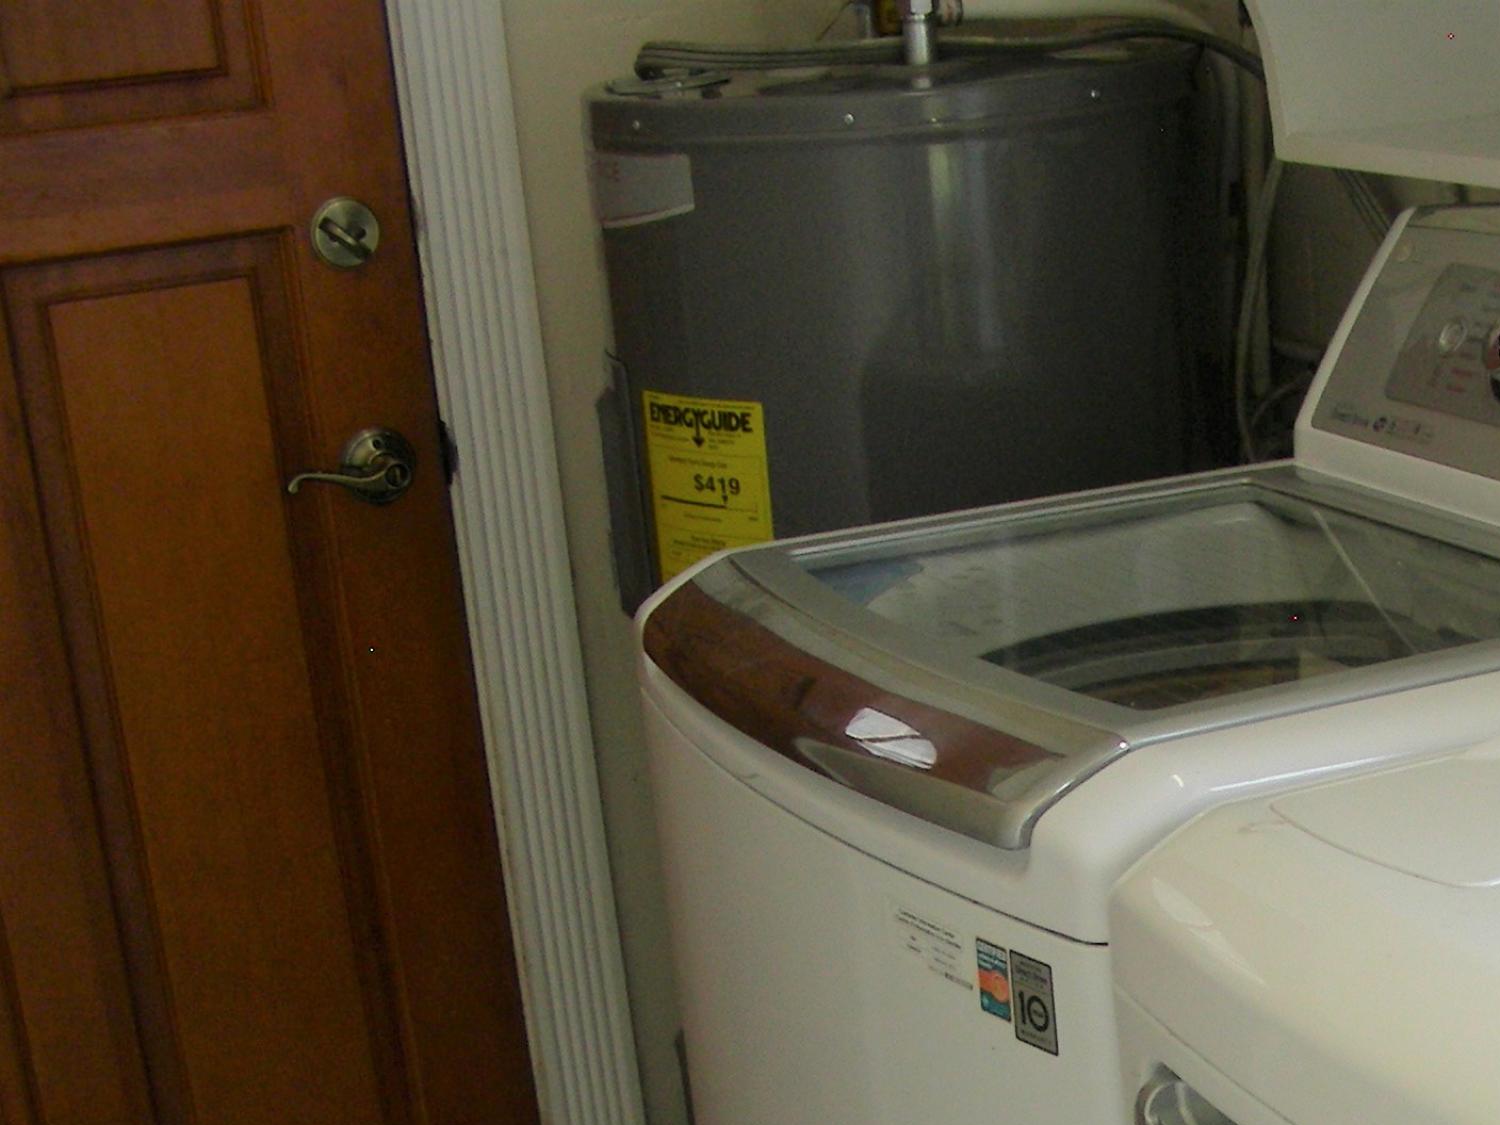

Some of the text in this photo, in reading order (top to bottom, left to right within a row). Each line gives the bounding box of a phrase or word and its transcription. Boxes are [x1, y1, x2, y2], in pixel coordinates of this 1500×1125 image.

[650, 402, 753, 433] ENERGYGUIDE
[693, 474, 740, 496] $419
[1018, 990, 1049, 1033] 10
